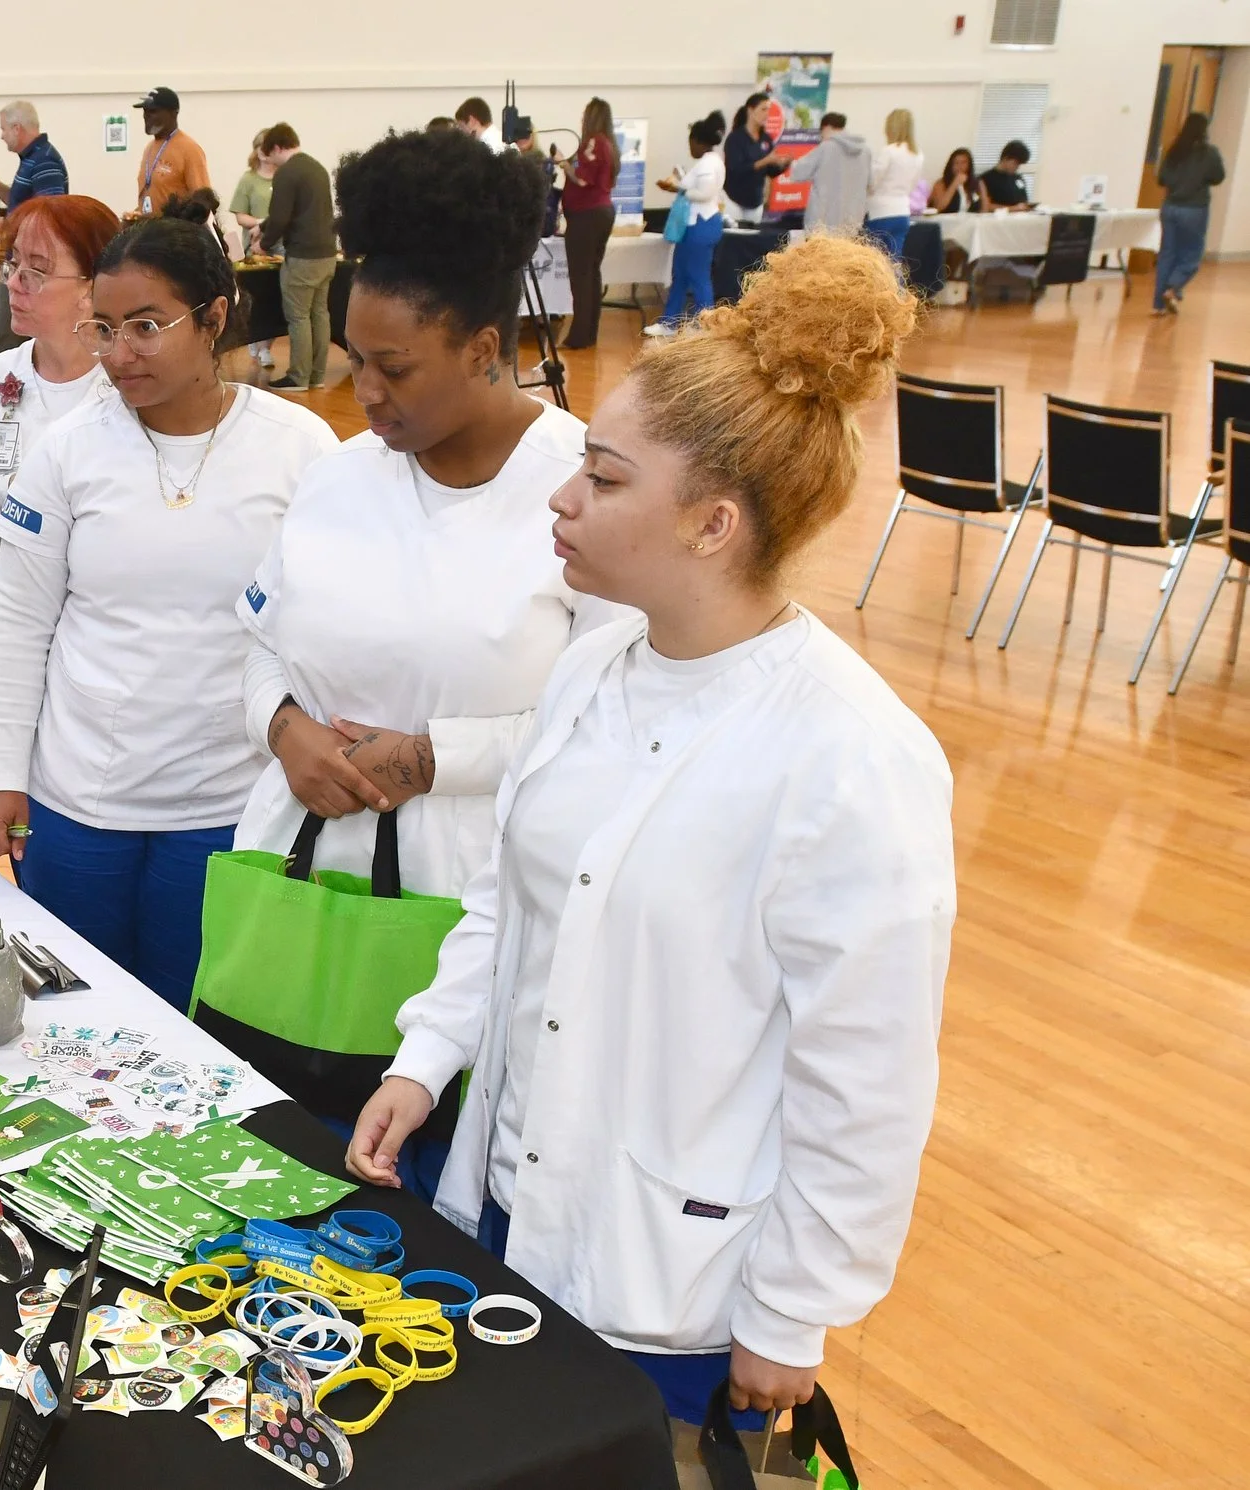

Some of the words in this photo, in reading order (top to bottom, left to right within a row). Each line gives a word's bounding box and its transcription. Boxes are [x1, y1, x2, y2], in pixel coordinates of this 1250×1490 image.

[104, 1114, 131, 1133] OVER
[279, 1246, 312, 1261] Someone
[273, 1266, 285, 1276] Be
[284, 1269, 299, 1283] You
[328, 1273, 340, 1284] Be
[339, 1279, 353, 1293] You
[187, 1313, 200, 1323] Be
[200, 1311, 214, 1321] You
[414, 1339, 453, 1350] acceptance
